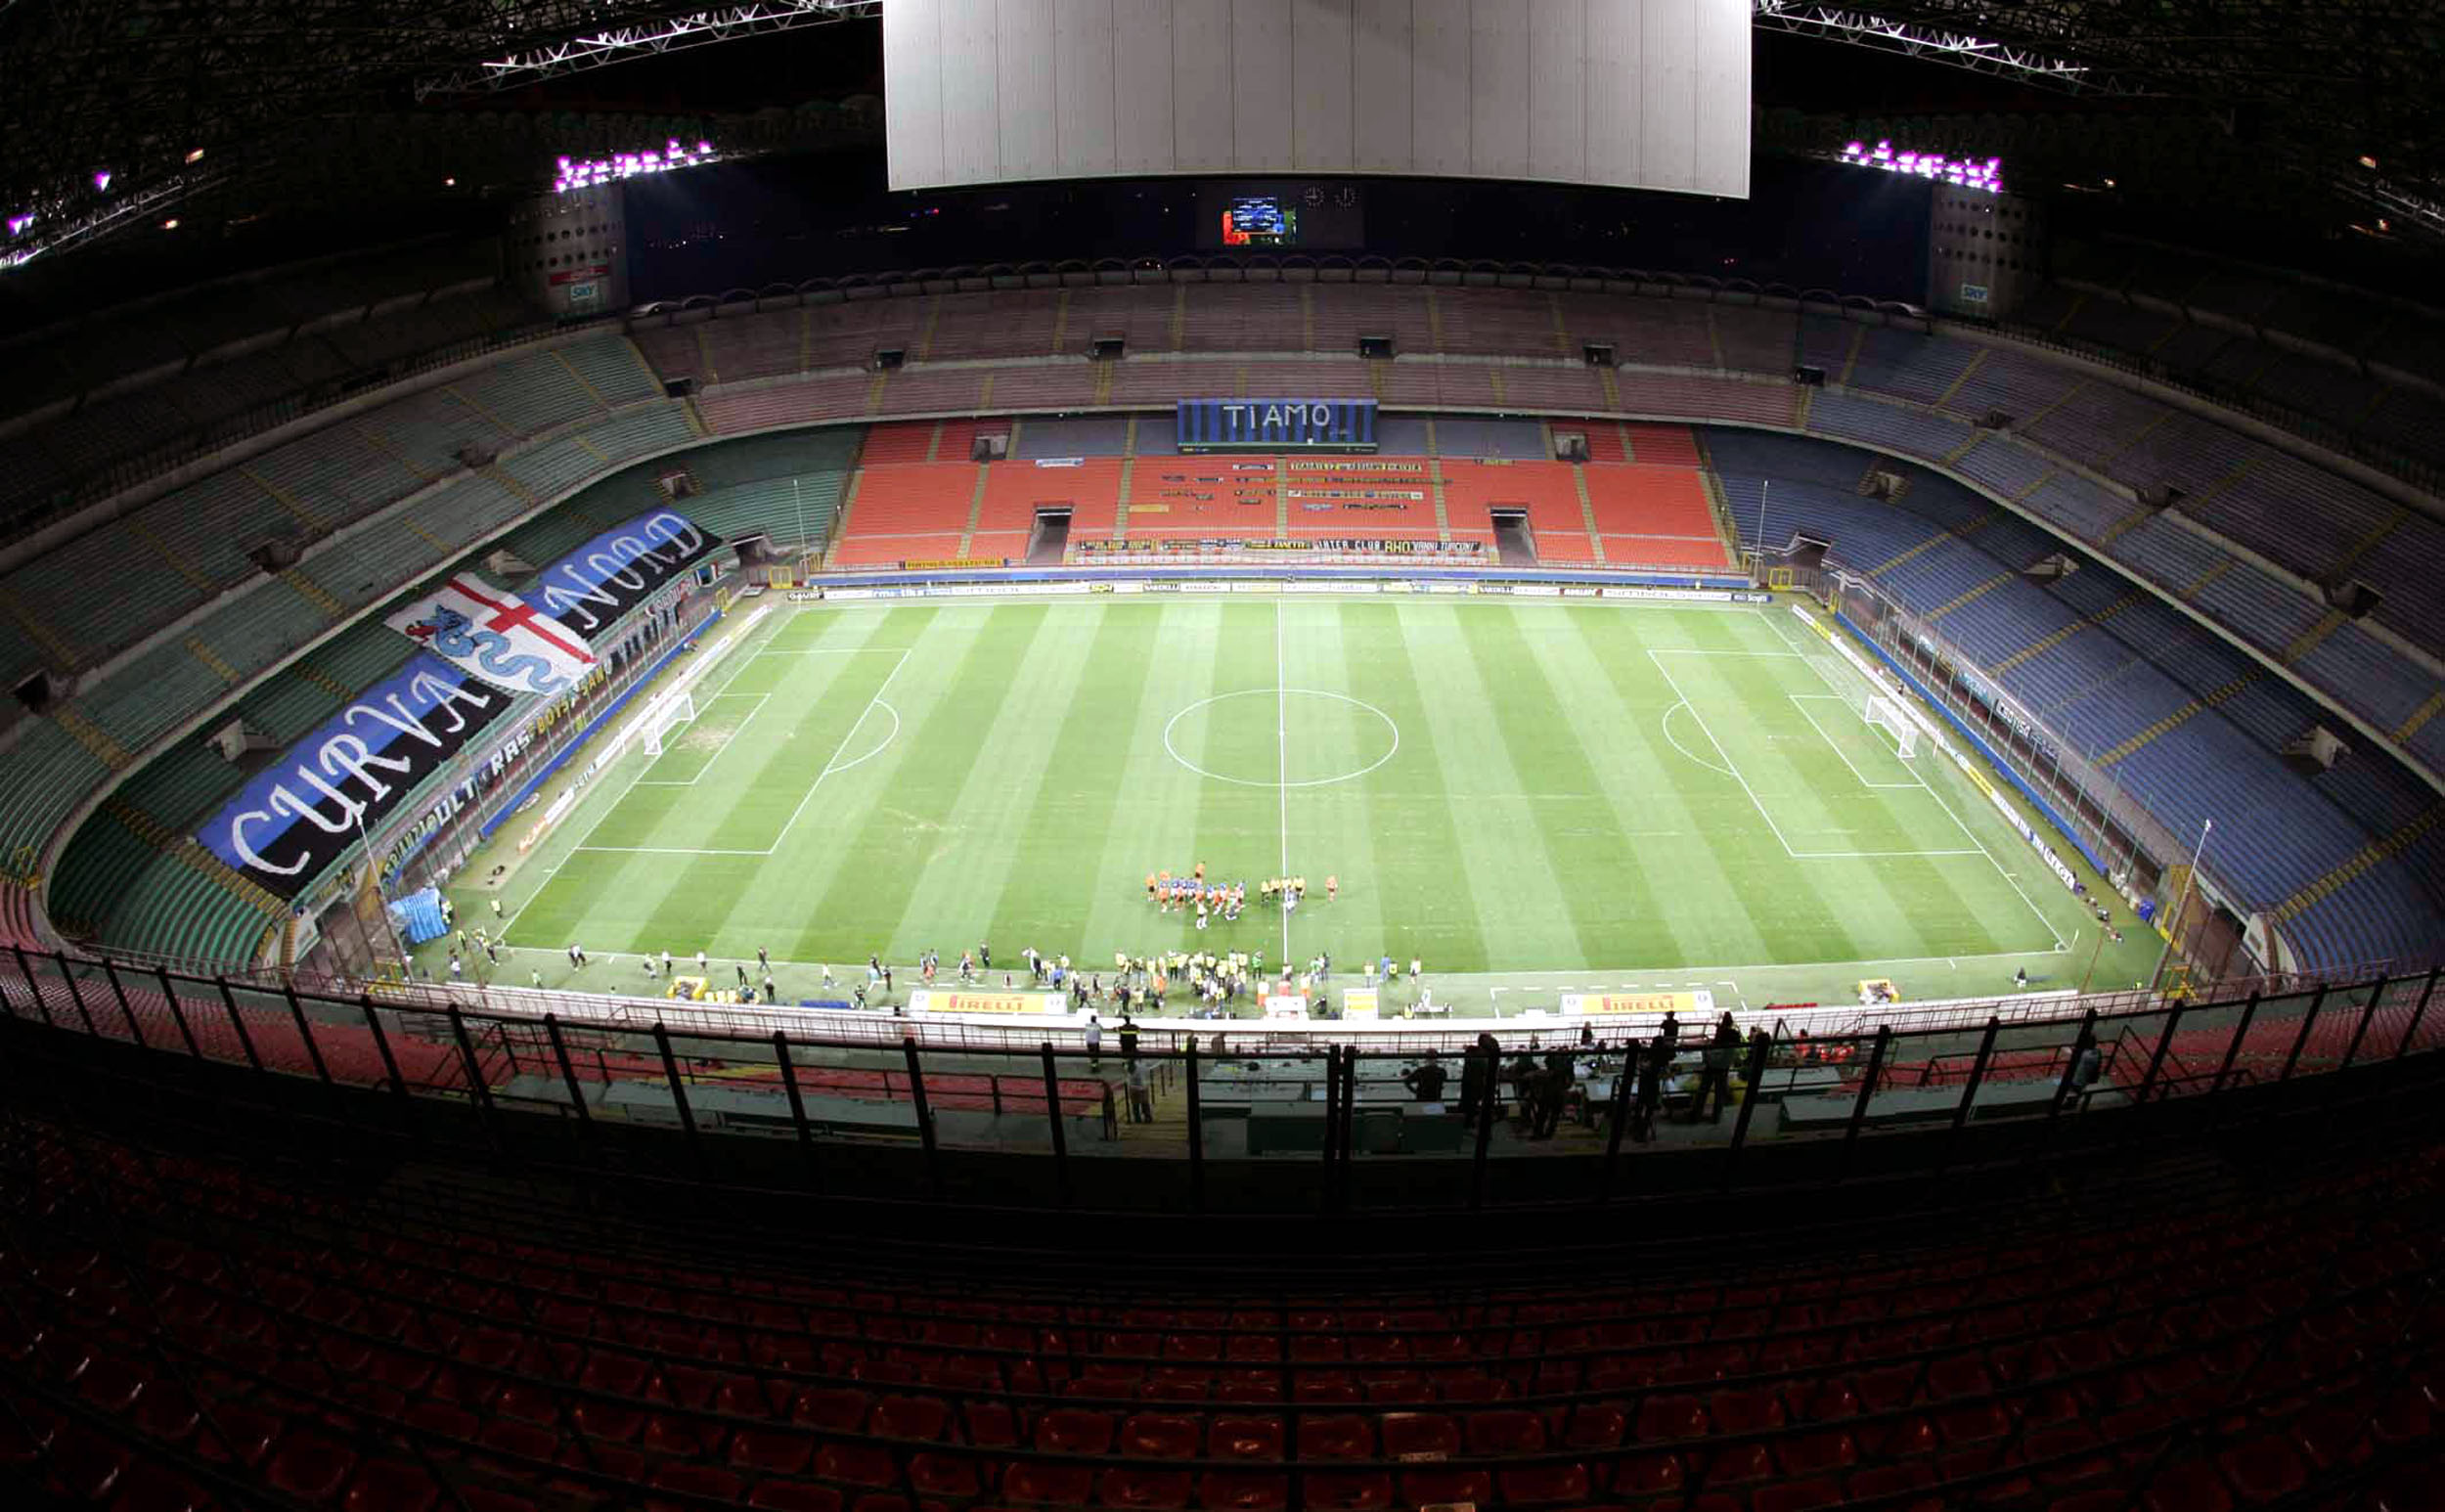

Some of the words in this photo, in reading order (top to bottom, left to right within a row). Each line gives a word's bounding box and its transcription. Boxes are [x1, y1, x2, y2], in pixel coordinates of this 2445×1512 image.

[1318, 540, 1349, 551] INTER
[1355, 540, 1380, 551] CLUB
[233, 672, 490, 875] CURVA
[544, 512, 703, 629] NORD
[949, 994, 1025, 1011] PIRELLI
[1602, 994, 1674, 1011] PIRELLI
